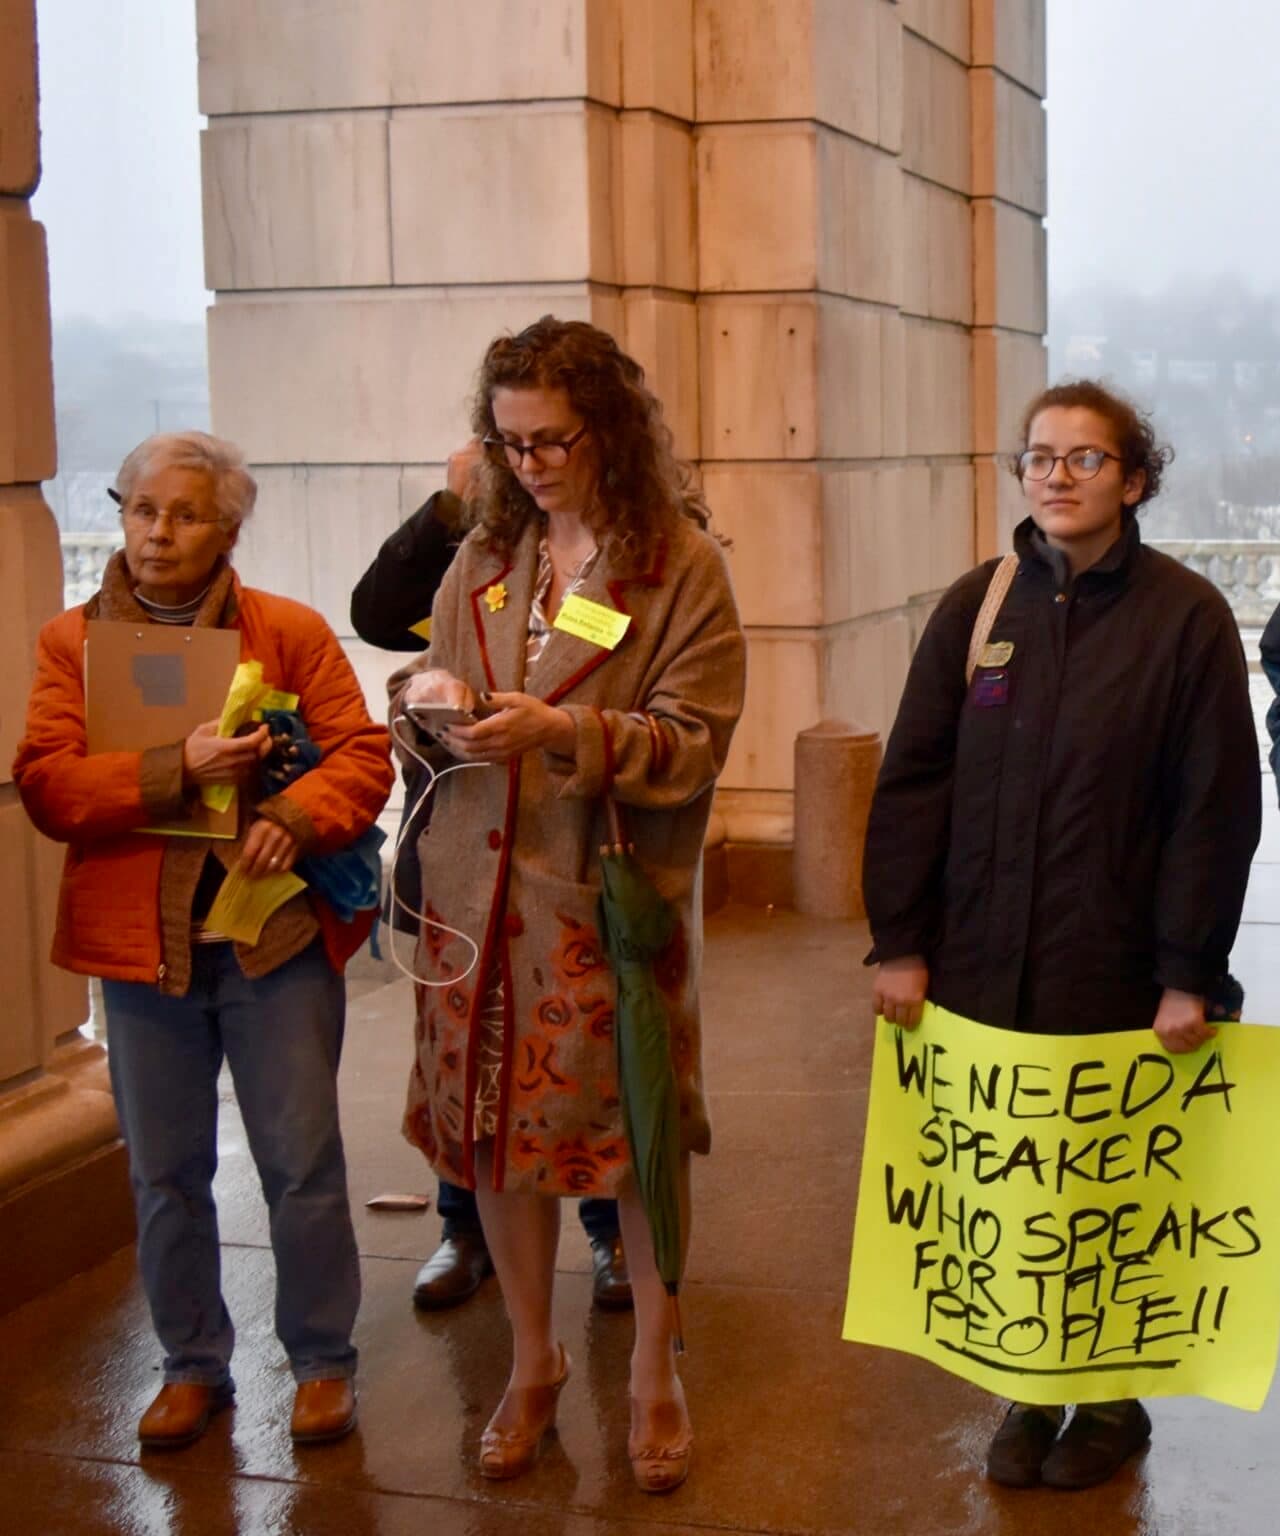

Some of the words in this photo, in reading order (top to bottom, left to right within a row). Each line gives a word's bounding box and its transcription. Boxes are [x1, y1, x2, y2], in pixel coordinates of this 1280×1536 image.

[894, 1027, 953, 1115] WE
[969, 1052, 1175, 1124] NEED
[1181, 1049, 1237, 1115] A
[918, 1114, 1184, 1195] SPEAKER
[884, 1163, 1002, 1259] WHO
[1017, 1202, 1263, 1270] SPEAKS
[912, 1239, 1007, 1317] FOR
[1016, 1252, 1164, 1317] THE
[924, 1285, 1231, 1364] PEOPLE!!
